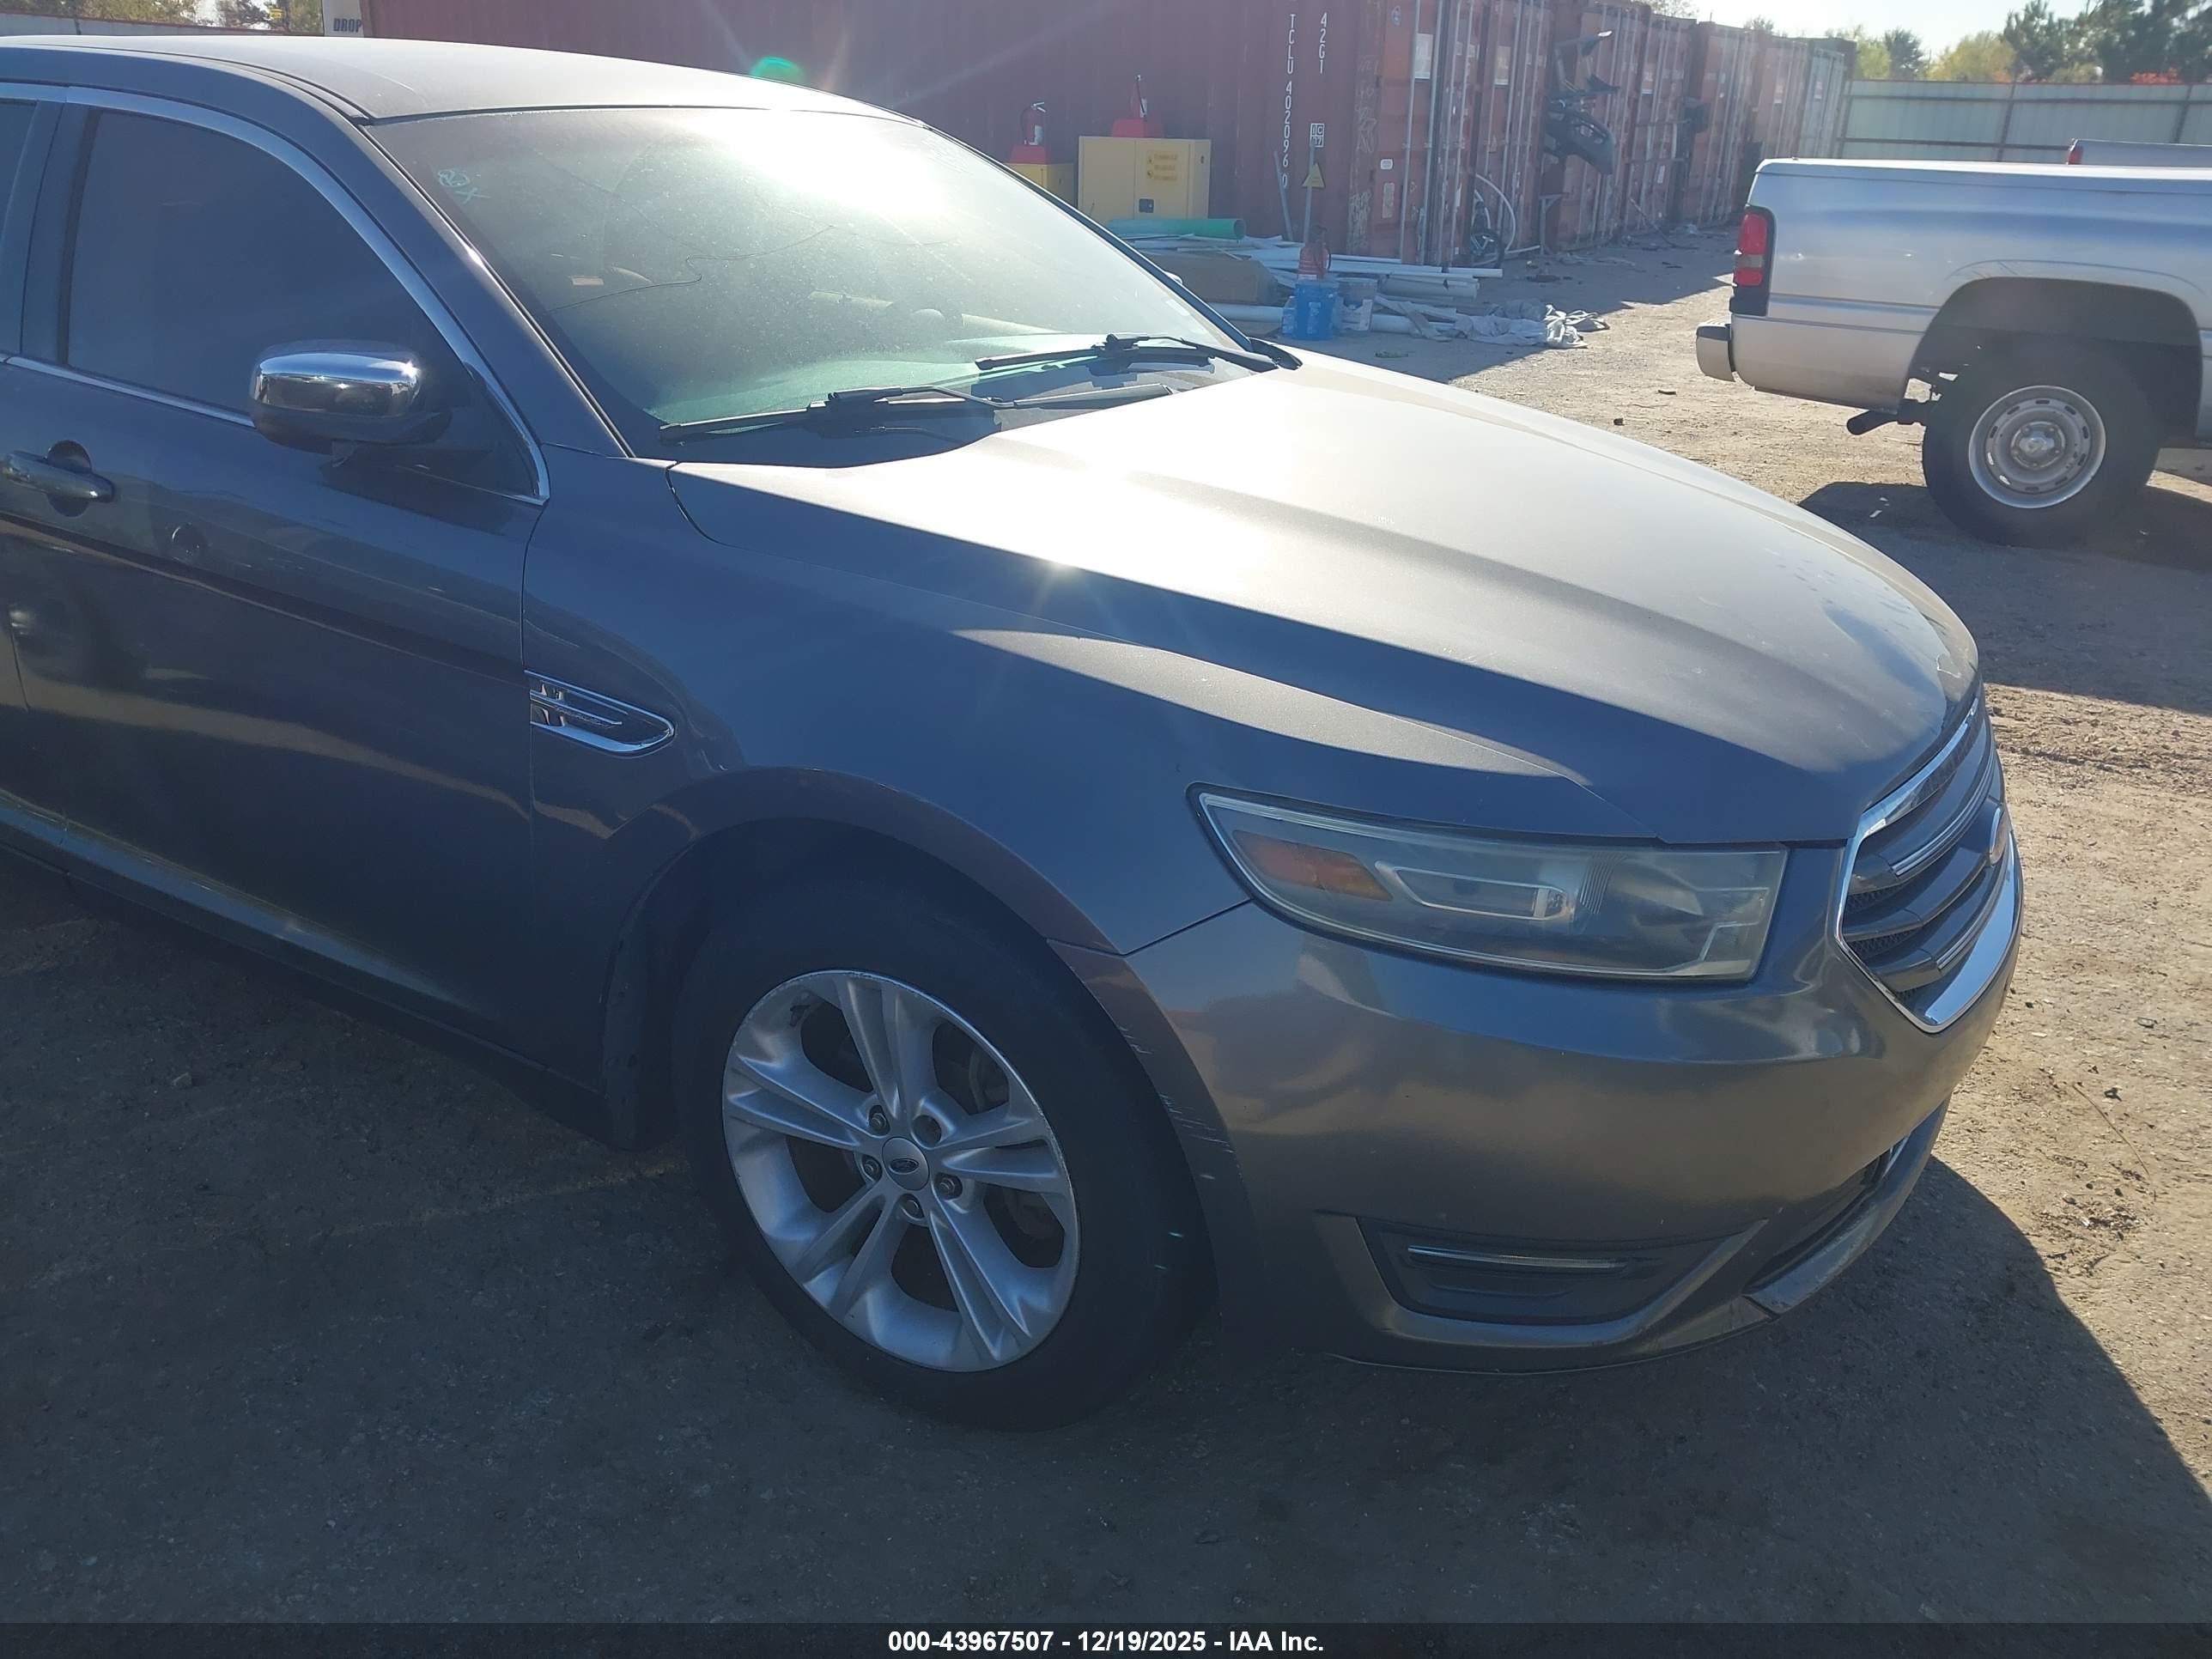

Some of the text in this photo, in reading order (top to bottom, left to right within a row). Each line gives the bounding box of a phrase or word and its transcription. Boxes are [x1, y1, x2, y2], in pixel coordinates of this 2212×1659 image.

[1287, 13, 1297, 75] TCLU
[1319, 12, 1328, 74] 42G1
[1283, 80, 1292, 167] 402096
